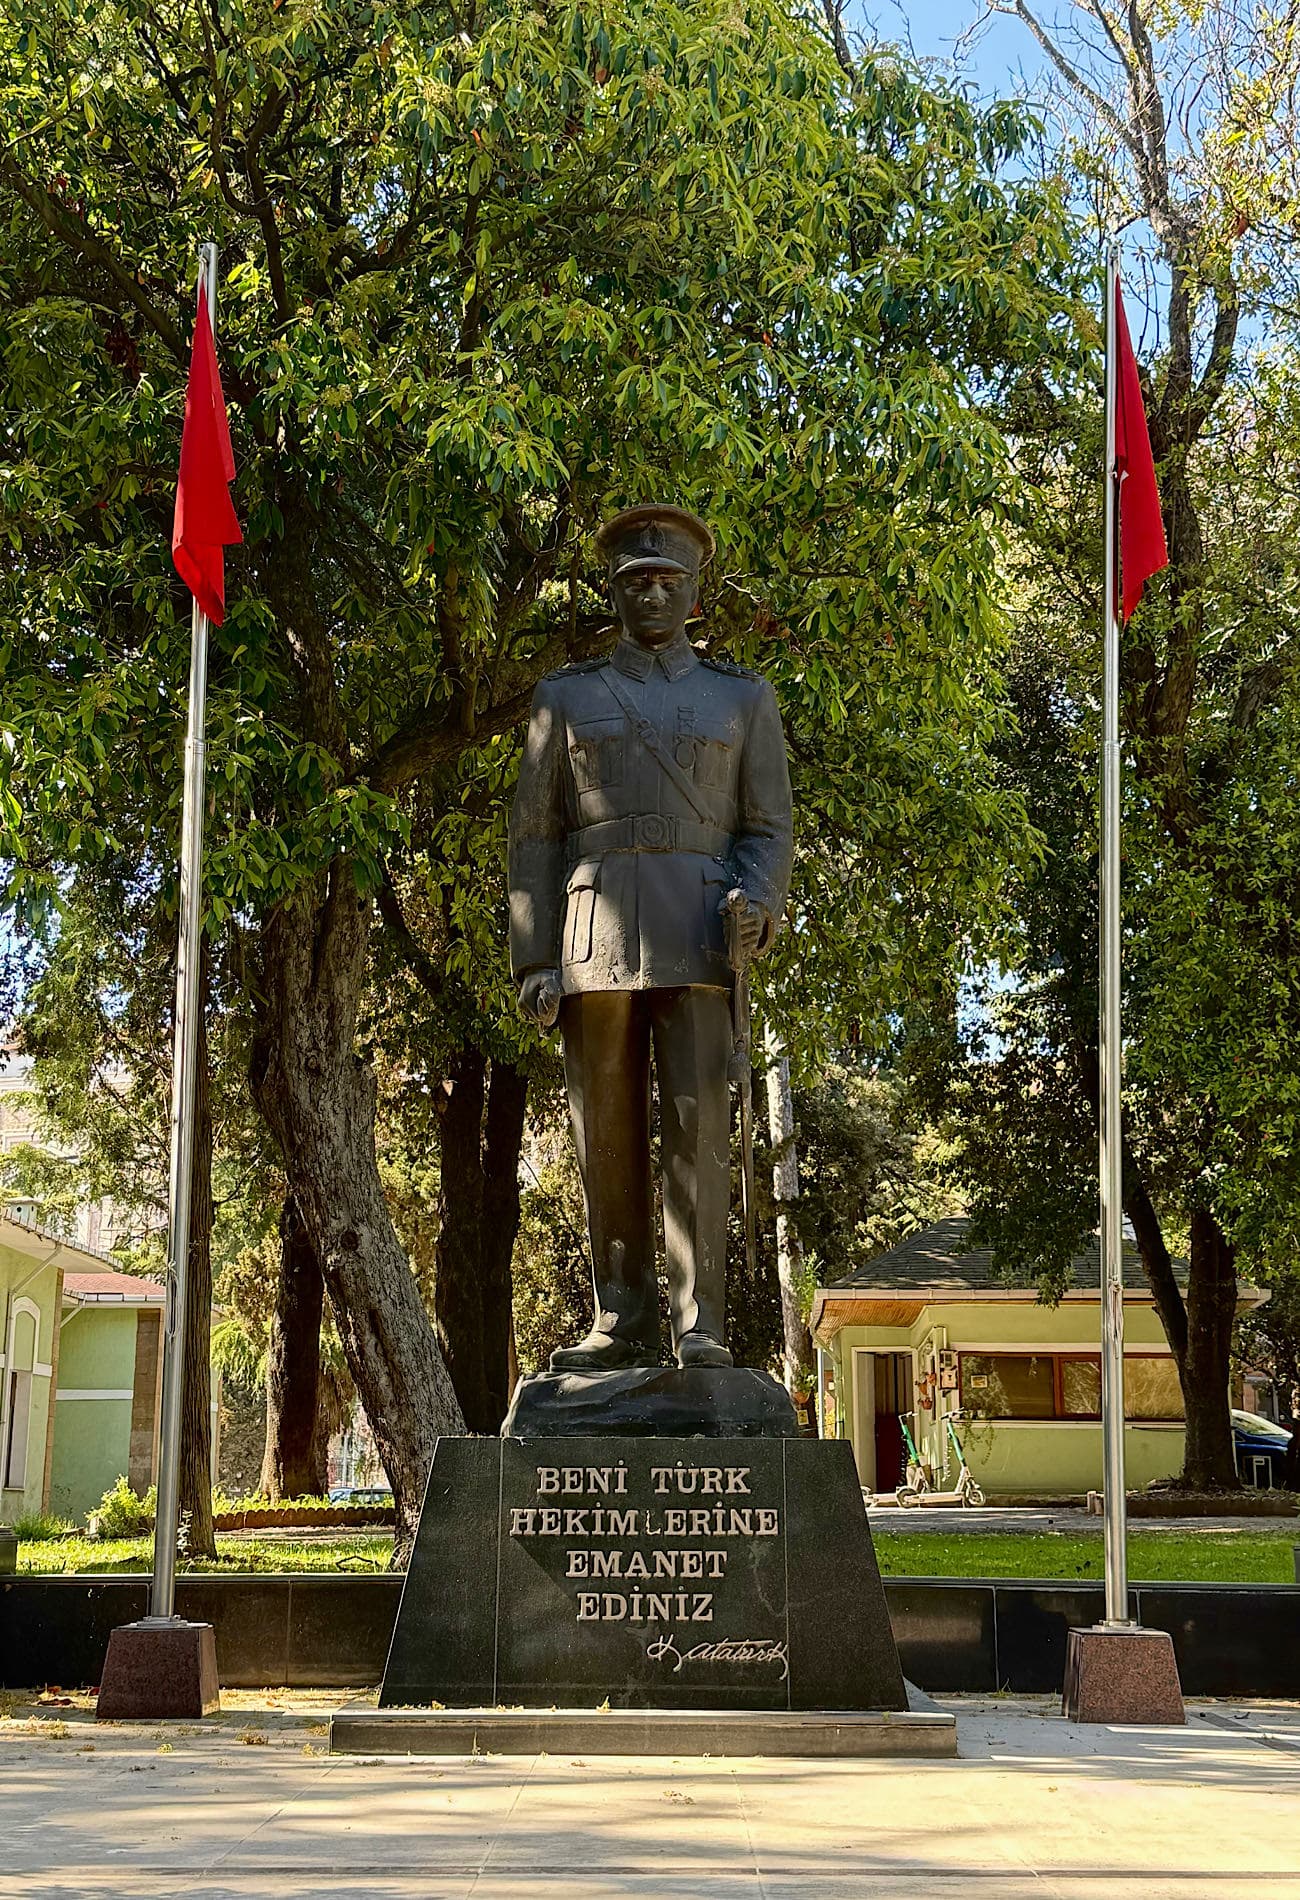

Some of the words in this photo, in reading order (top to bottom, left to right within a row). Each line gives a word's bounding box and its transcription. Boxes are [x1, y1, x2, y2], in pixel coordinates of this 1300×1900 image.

[537, 1460, 628, 1494] BENİ
[651, 1461, 751, 1494] TÜRK
[565, 1550, 728, 1578] EMANET
[576, 1585, 714, 1621] EDİNİZ
